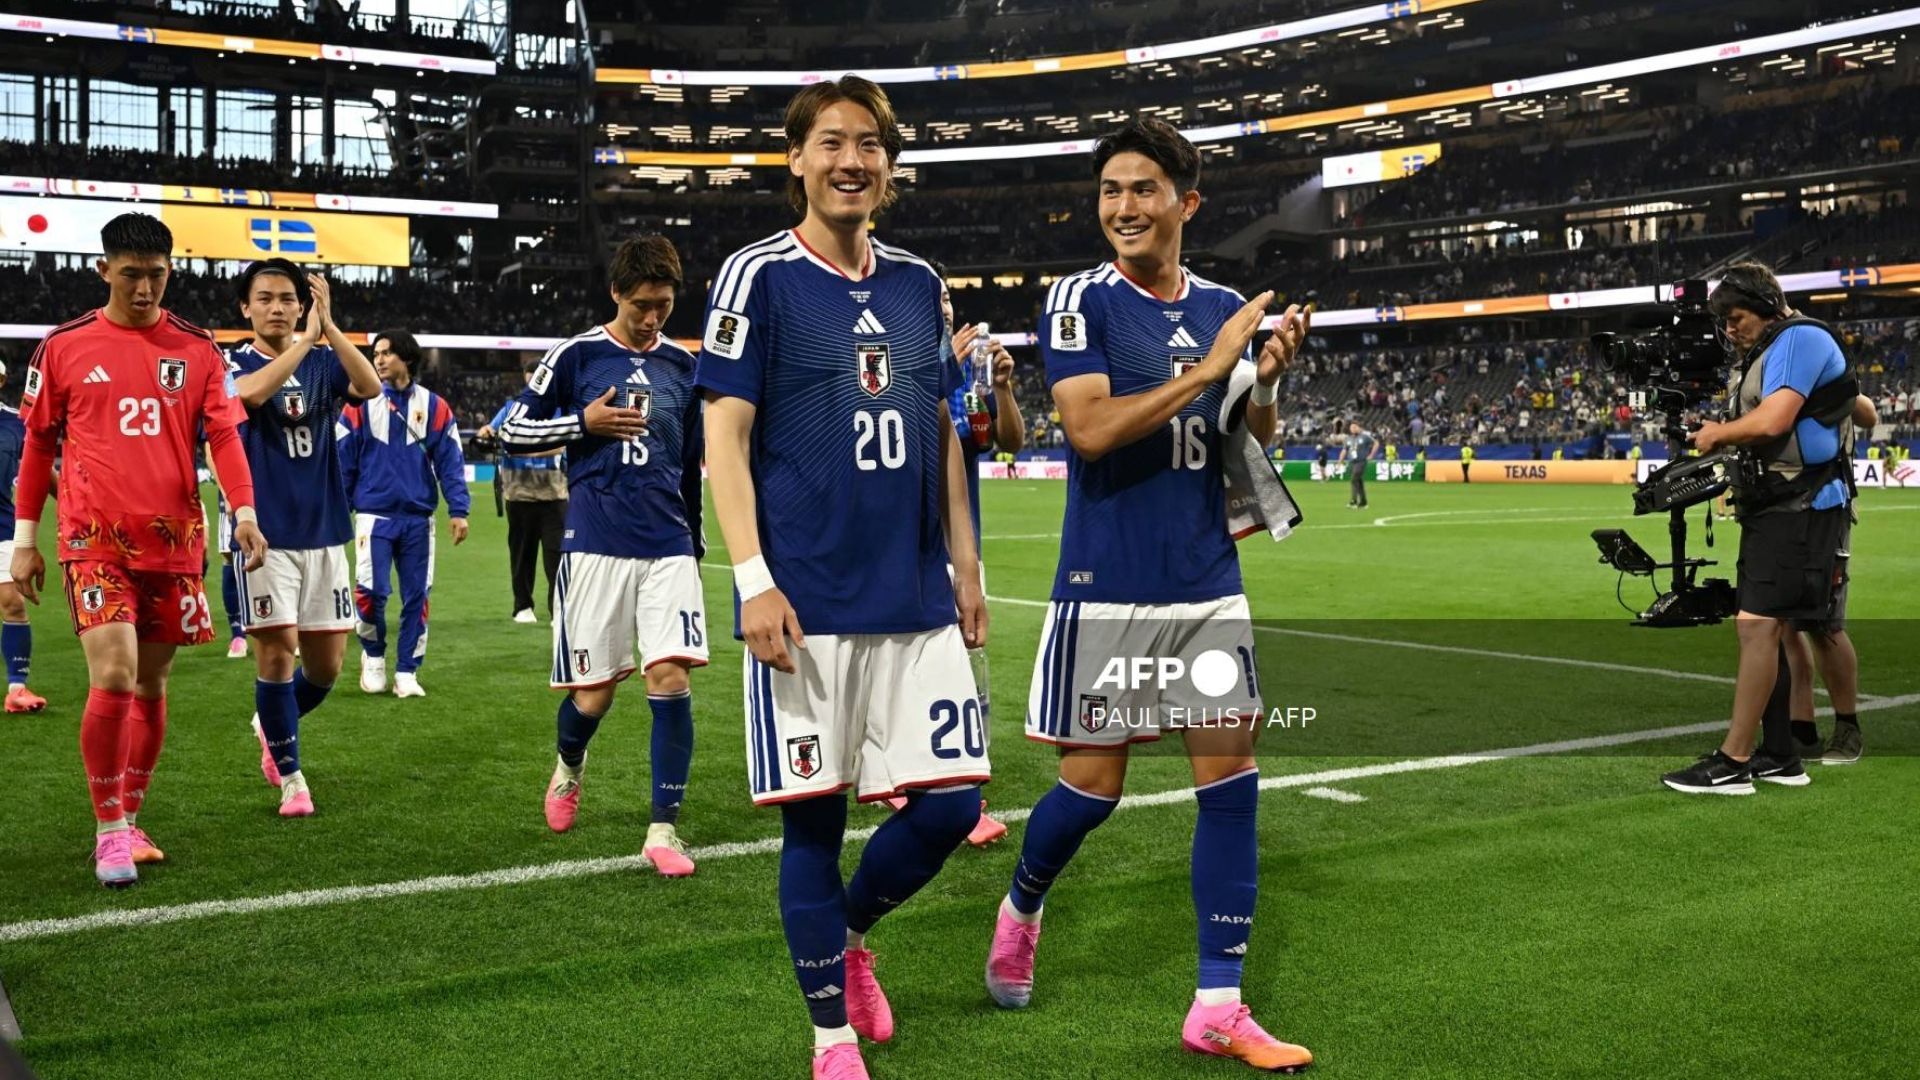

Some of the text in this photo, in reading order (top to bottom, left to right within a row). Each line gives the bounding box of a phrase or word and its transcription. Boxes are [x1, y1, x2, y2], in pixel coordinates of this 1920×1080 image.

[118, 397, 161, 436] 23
[283, 426, 313, 458] 18
[853, 410, 906, 470] 20
[1169, 415, 1207, 470] 16
[1504, 465, 1547, 479] TEXAS
[180, 591, 212, 634] 23
[333, 587, 352, 619] 18
[680, 610, 703, 647] 15
[929, 698, 985, 759] 20
